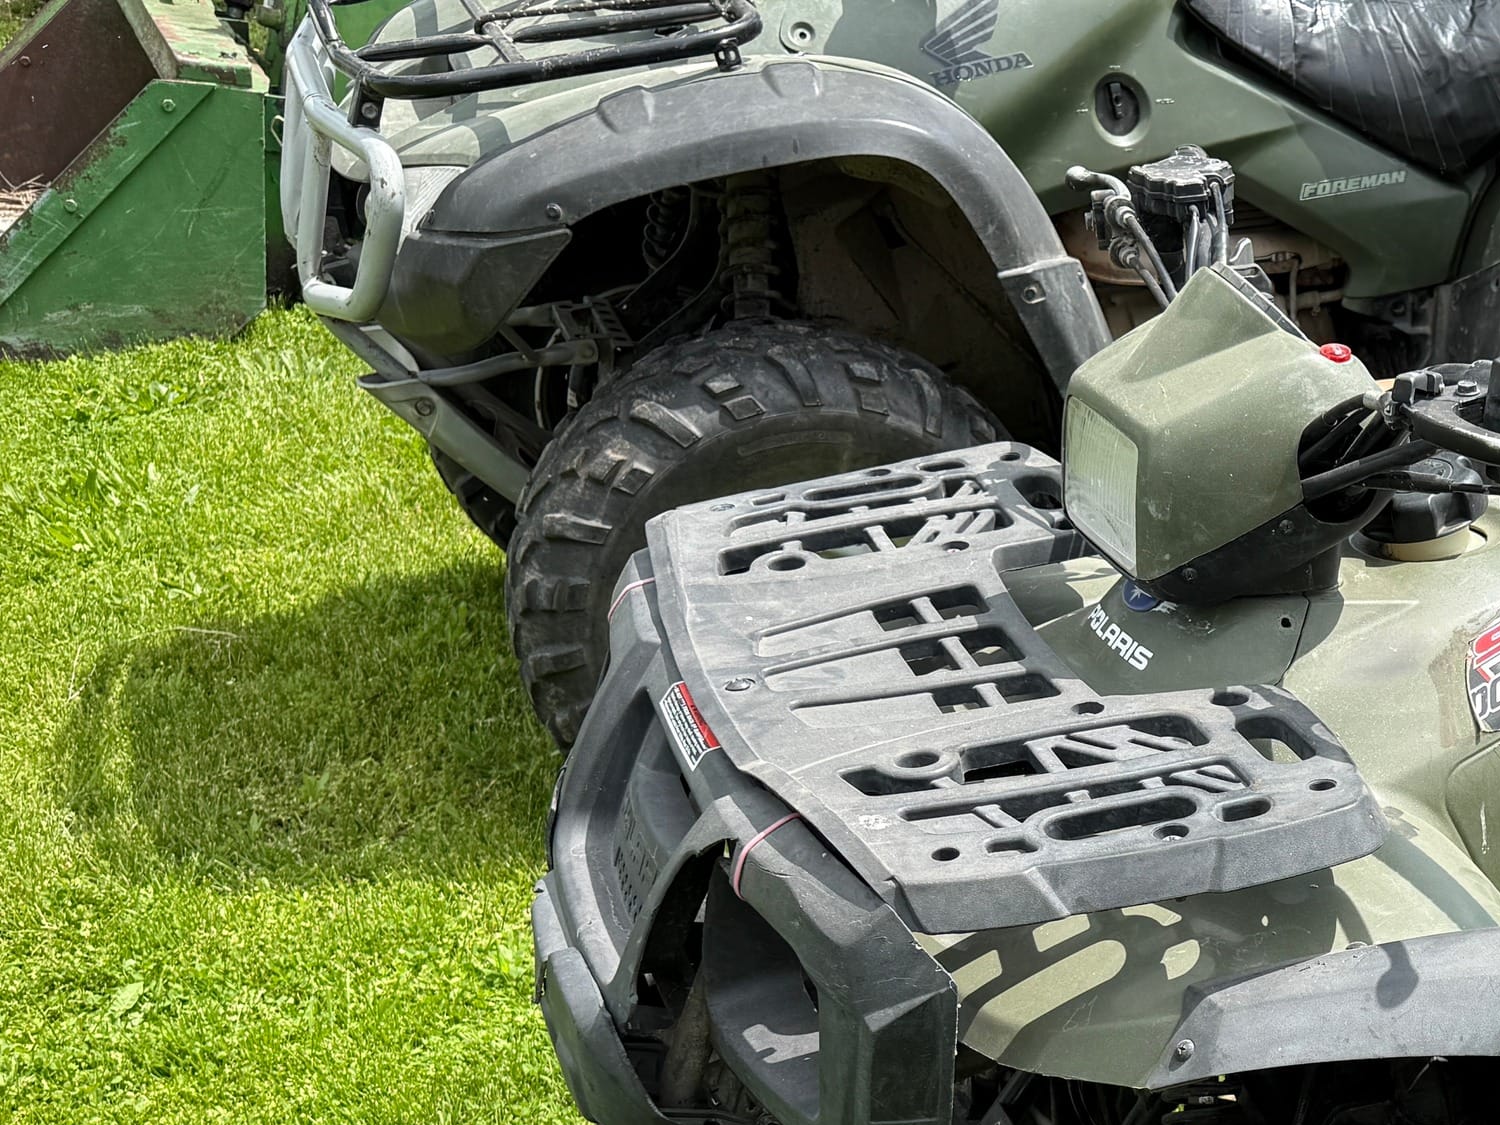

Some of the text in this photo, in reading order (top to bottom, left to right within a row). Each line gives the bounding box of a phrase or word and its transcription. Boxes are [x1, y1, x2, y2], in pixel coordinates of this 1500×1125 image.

[929, 53, 1033, 86] HONDA
[1302, 169, 1406, 198] FOREMAN
[1088, 603, 1154, 671] POLARIS
